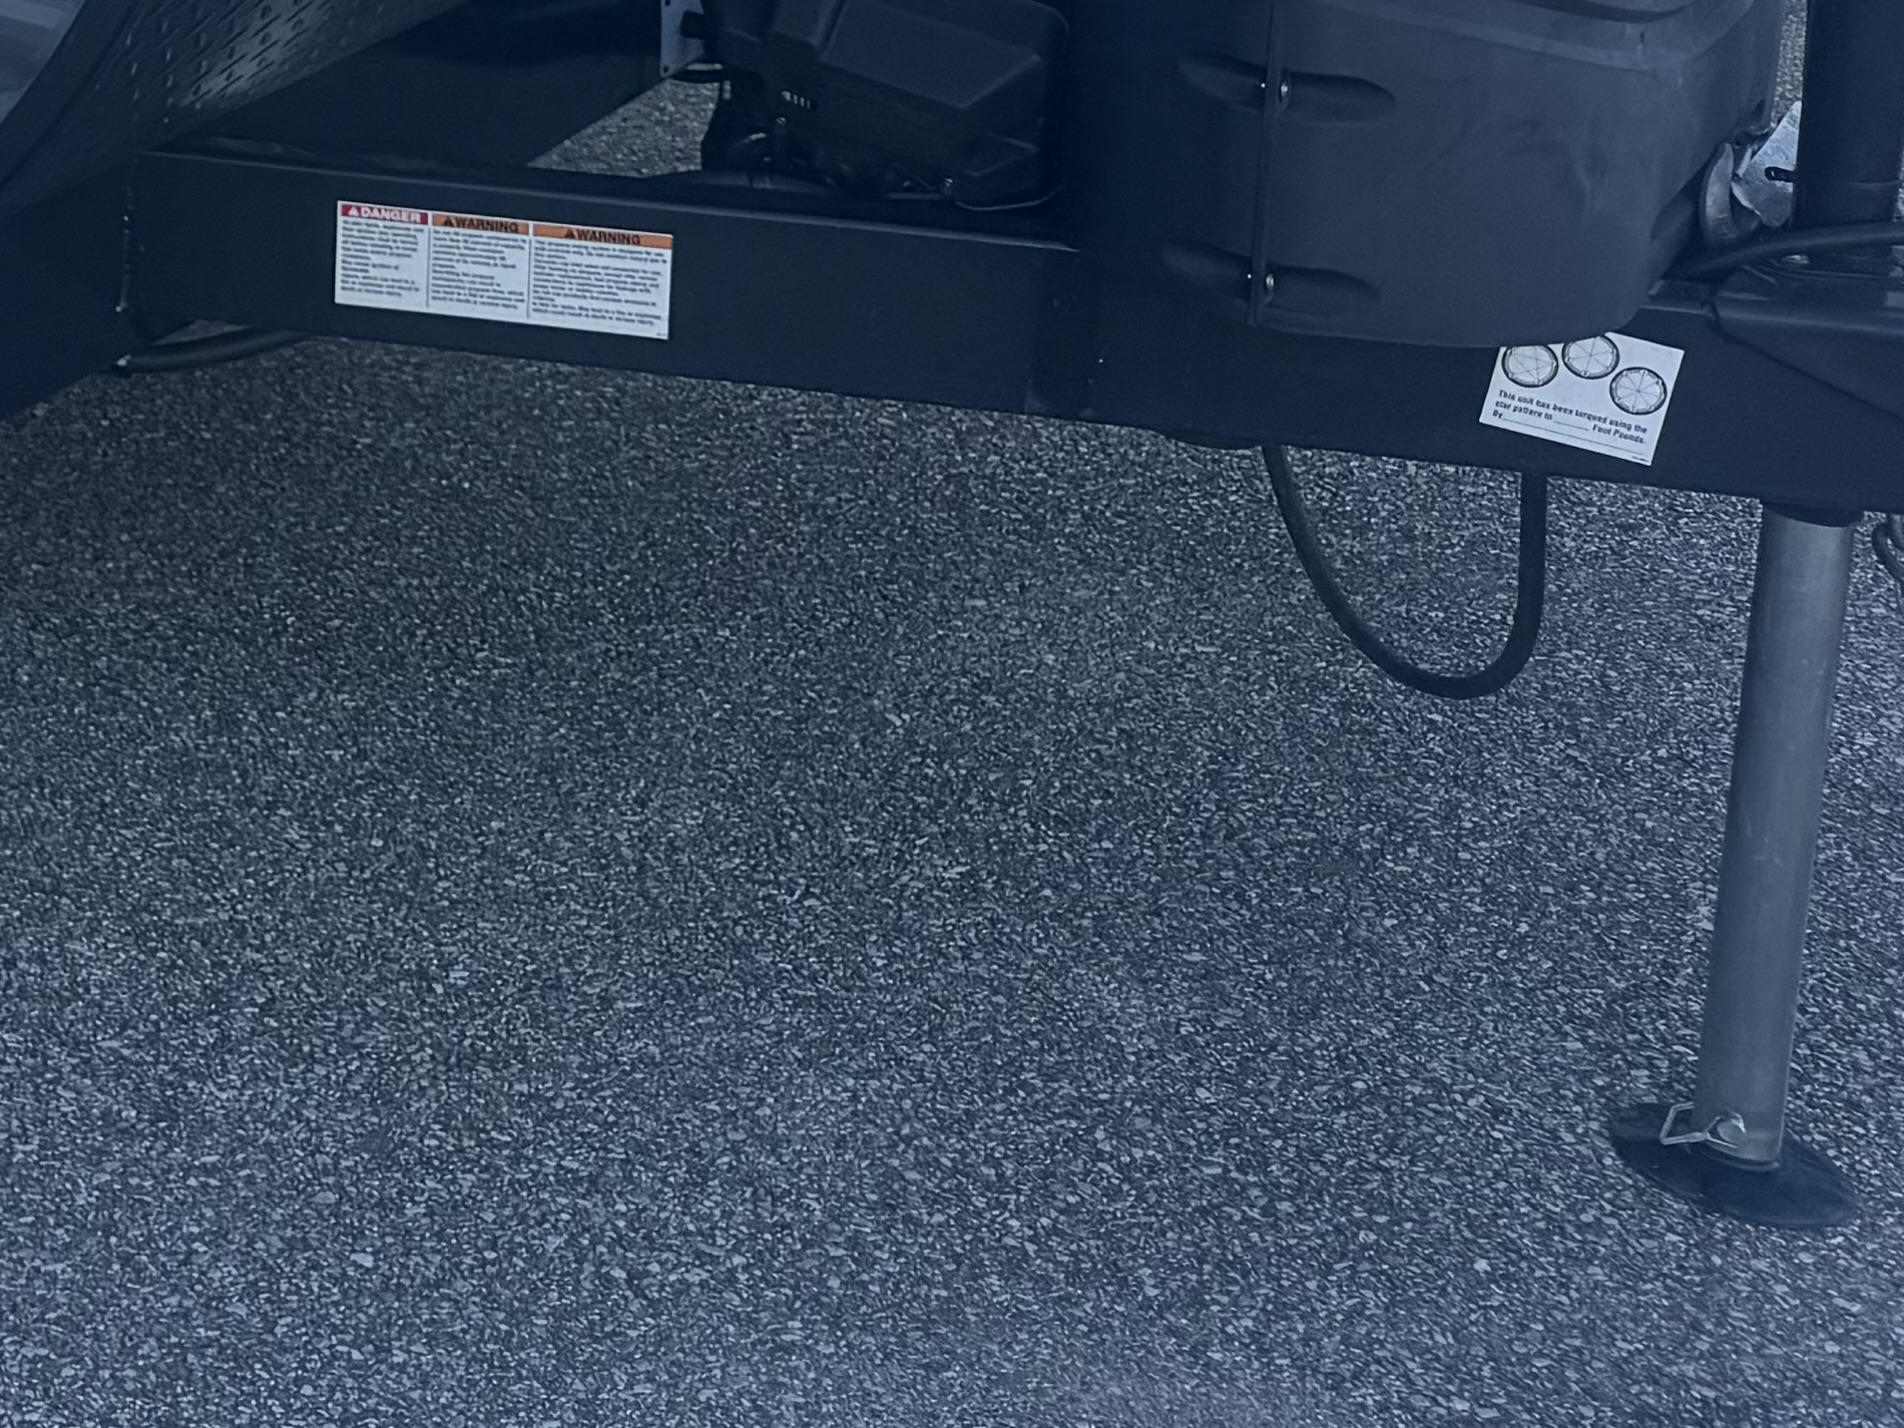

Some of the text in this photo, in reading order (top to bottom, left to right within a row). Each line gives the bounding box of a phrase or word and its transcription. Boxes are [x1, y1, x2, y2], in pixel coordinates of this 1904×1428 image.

[361, 207, 422, 223] DANGER
[455, 217, 519, 233] WARNING
[576, 229, 641, 246] WARNING
